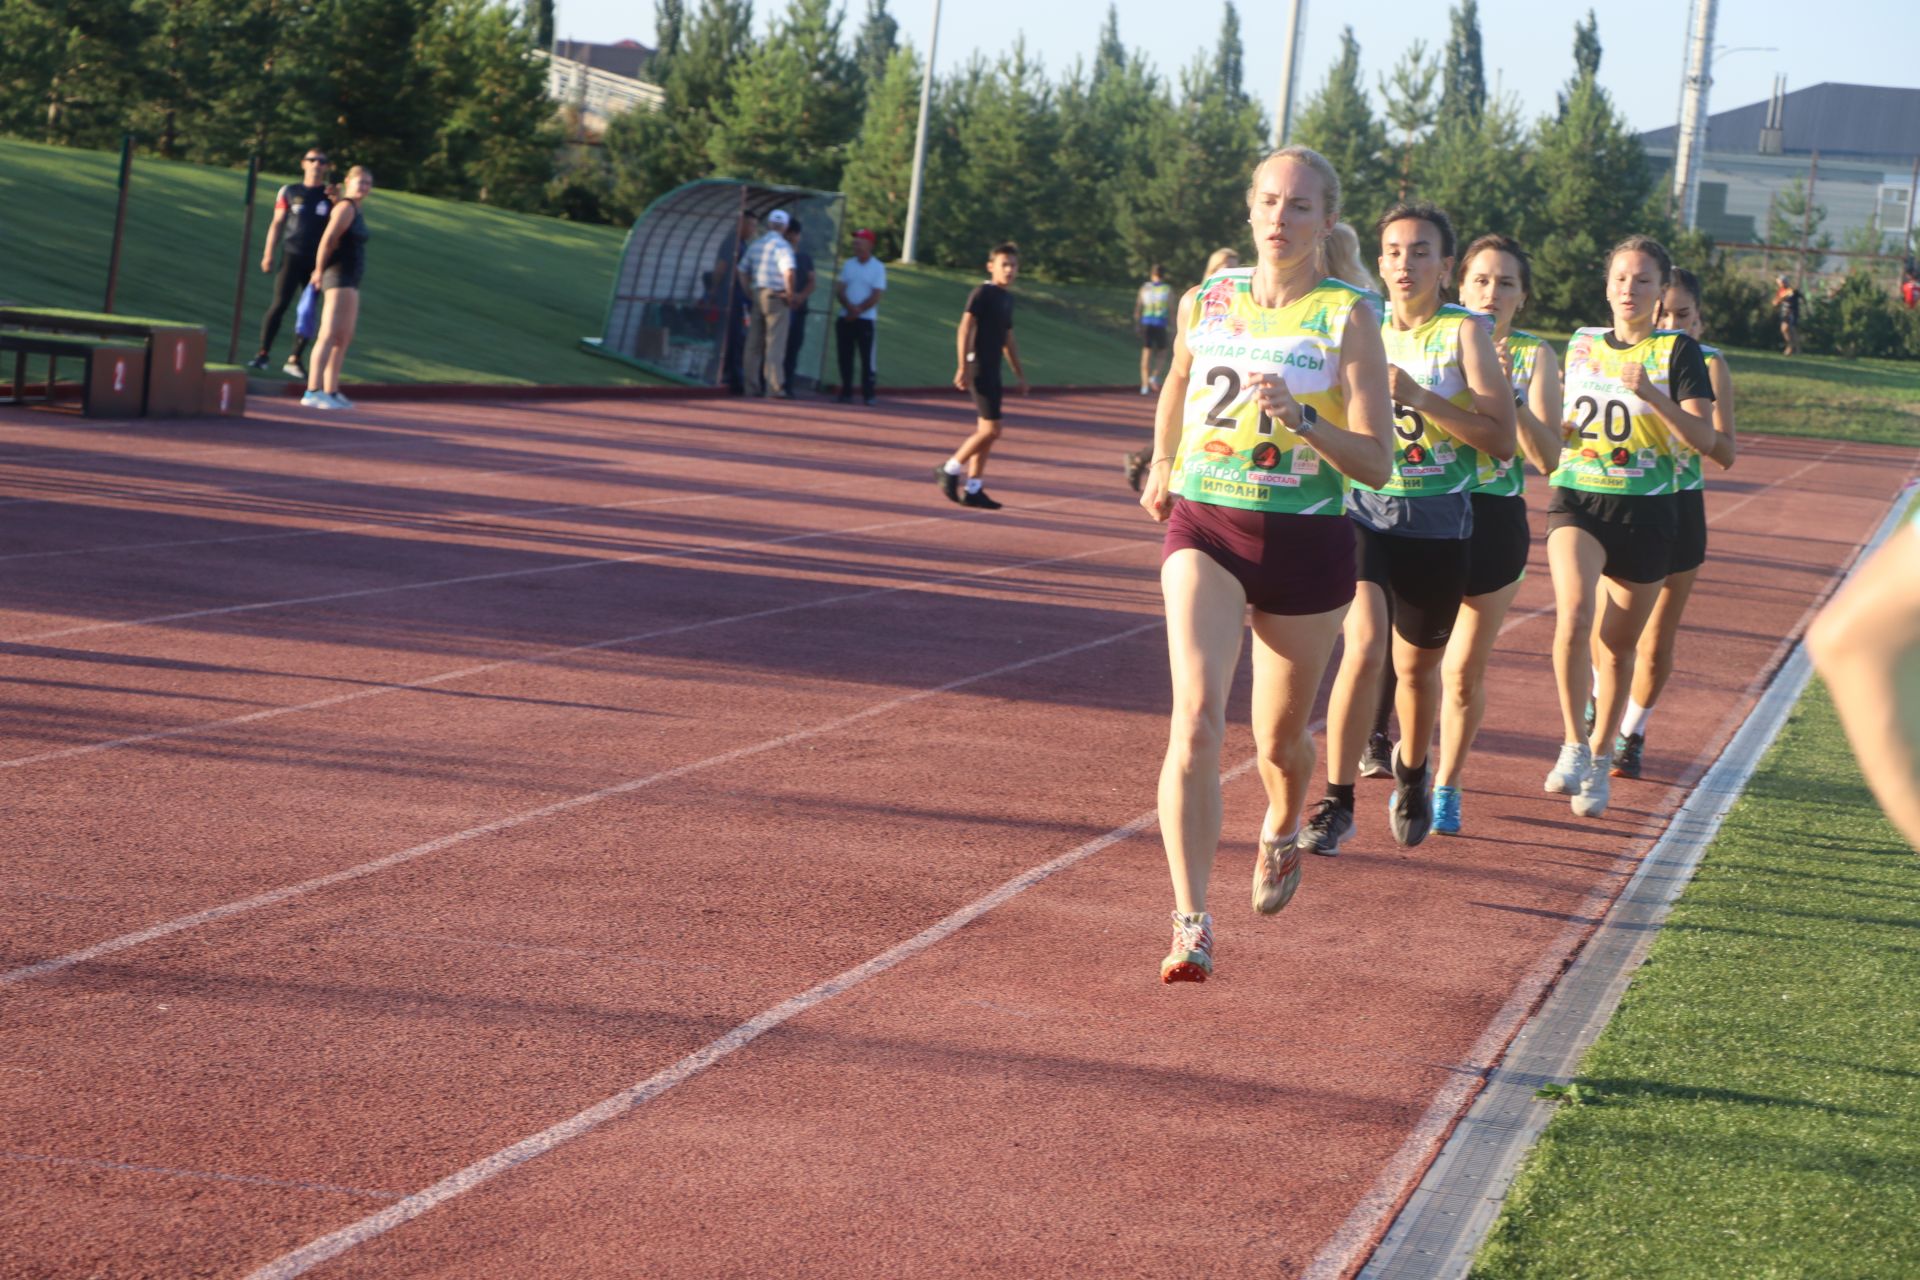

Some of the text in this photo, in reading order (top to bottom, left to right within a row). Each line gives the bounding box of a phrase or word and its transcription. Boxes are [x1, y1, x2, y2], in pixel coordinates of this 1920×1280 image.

[1249, 347, 1325, 371] САБАСЫ
[1575, 395, 1632, 442] 20
[1203, 480, 1268, 499] ИЛФАНИ
